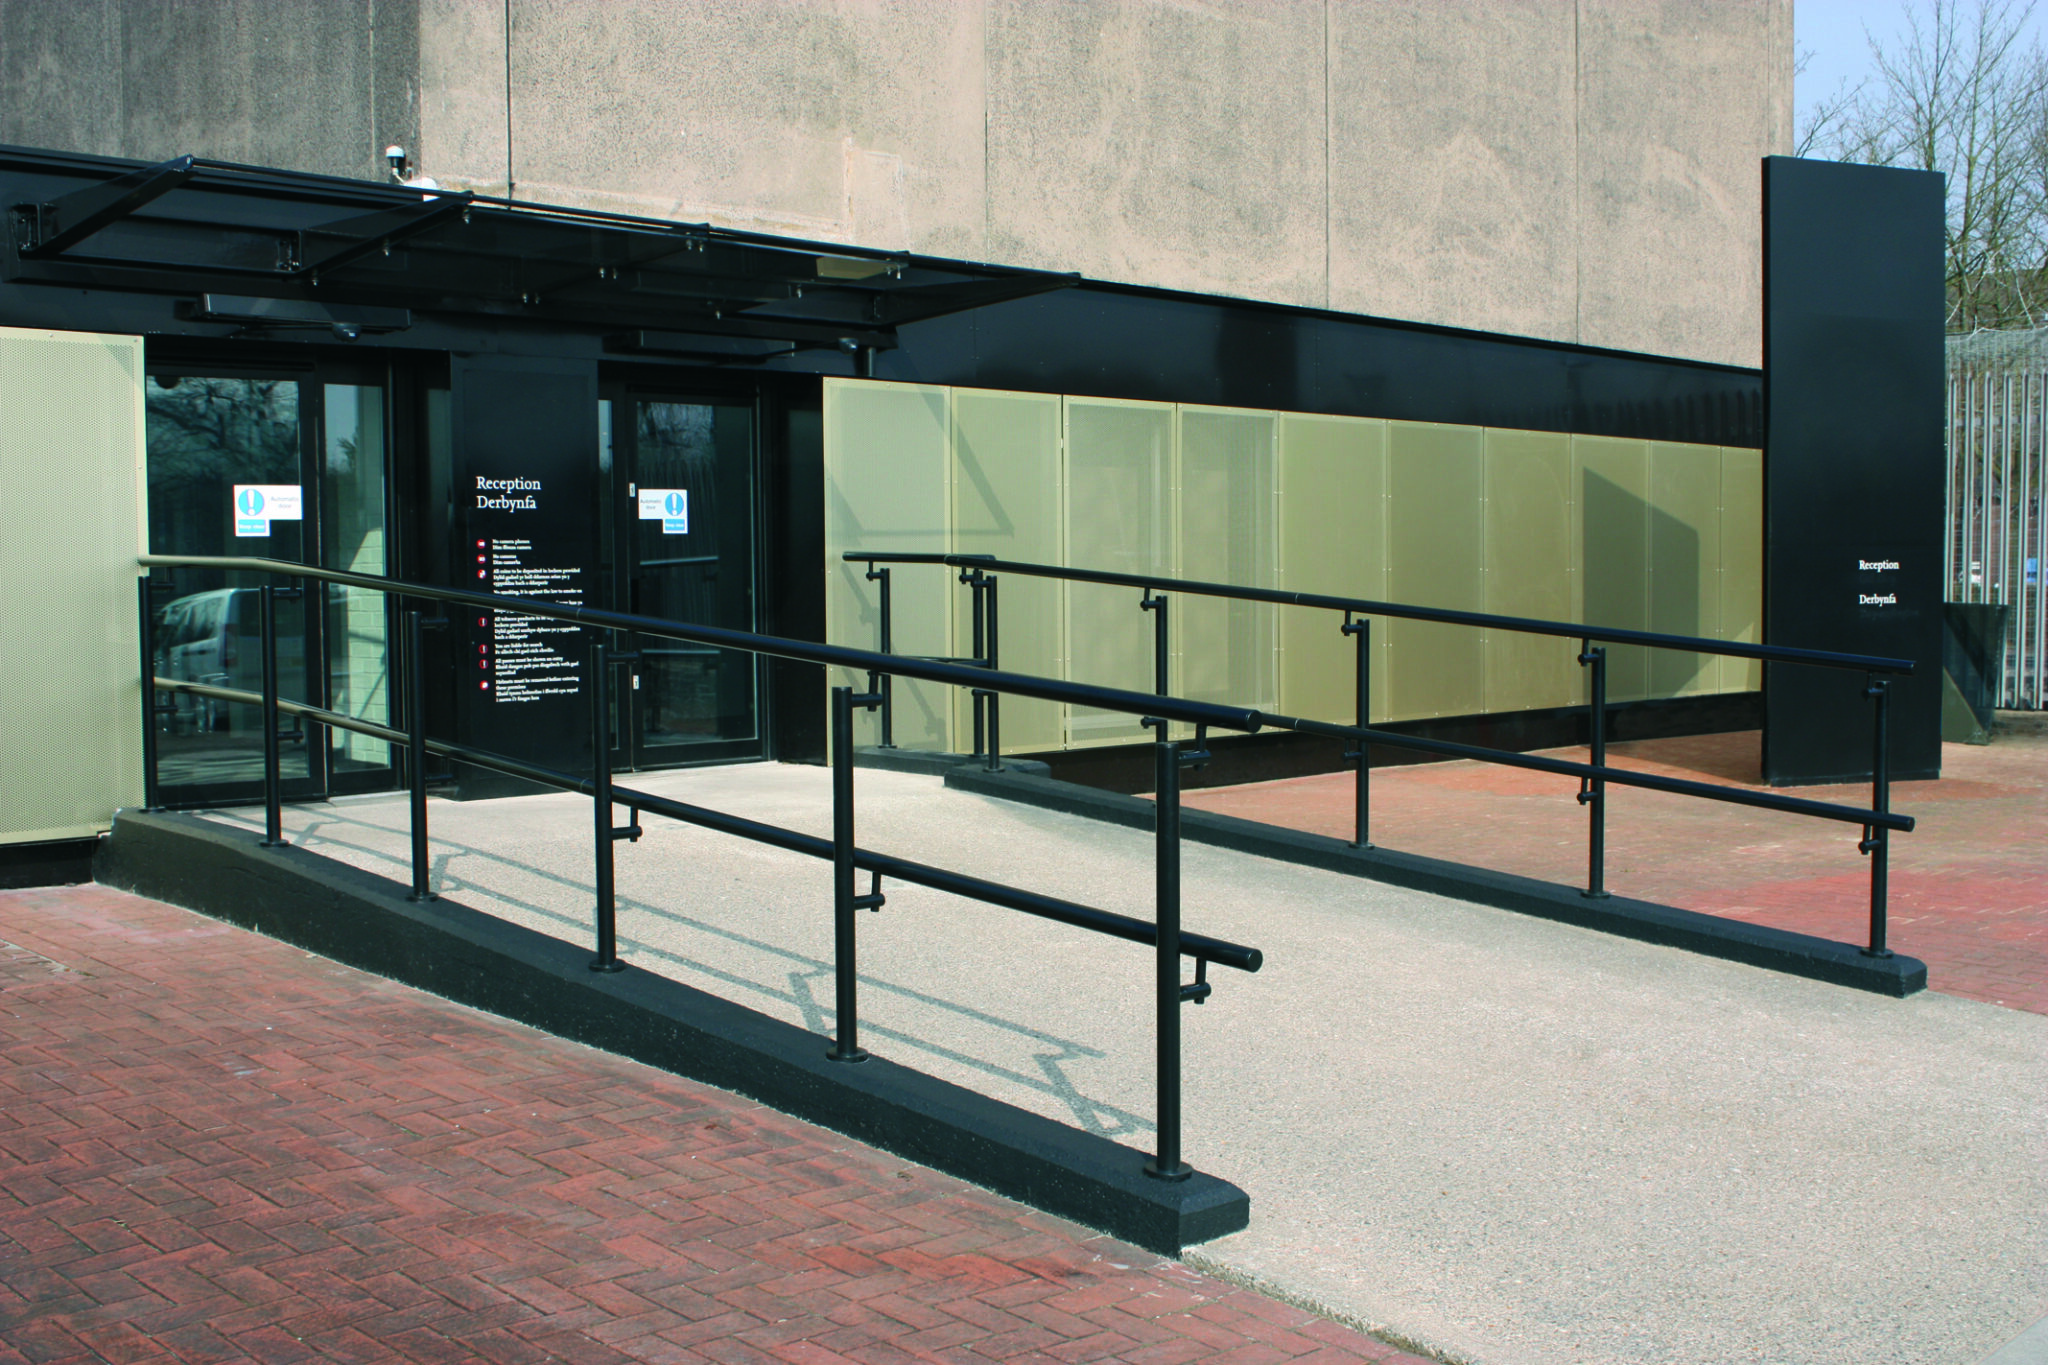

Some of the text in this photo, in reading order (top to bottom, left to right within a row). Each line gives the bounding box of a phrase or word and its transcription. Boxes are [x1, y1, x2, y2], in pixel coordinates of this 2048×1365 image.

[476, 475, 542, 494] Reception
[476, 494, 538, 513] Derbynfa
[1858, 559, 1901, 573] Reception
[1858, 592, 1898, 607] Derbynfa
